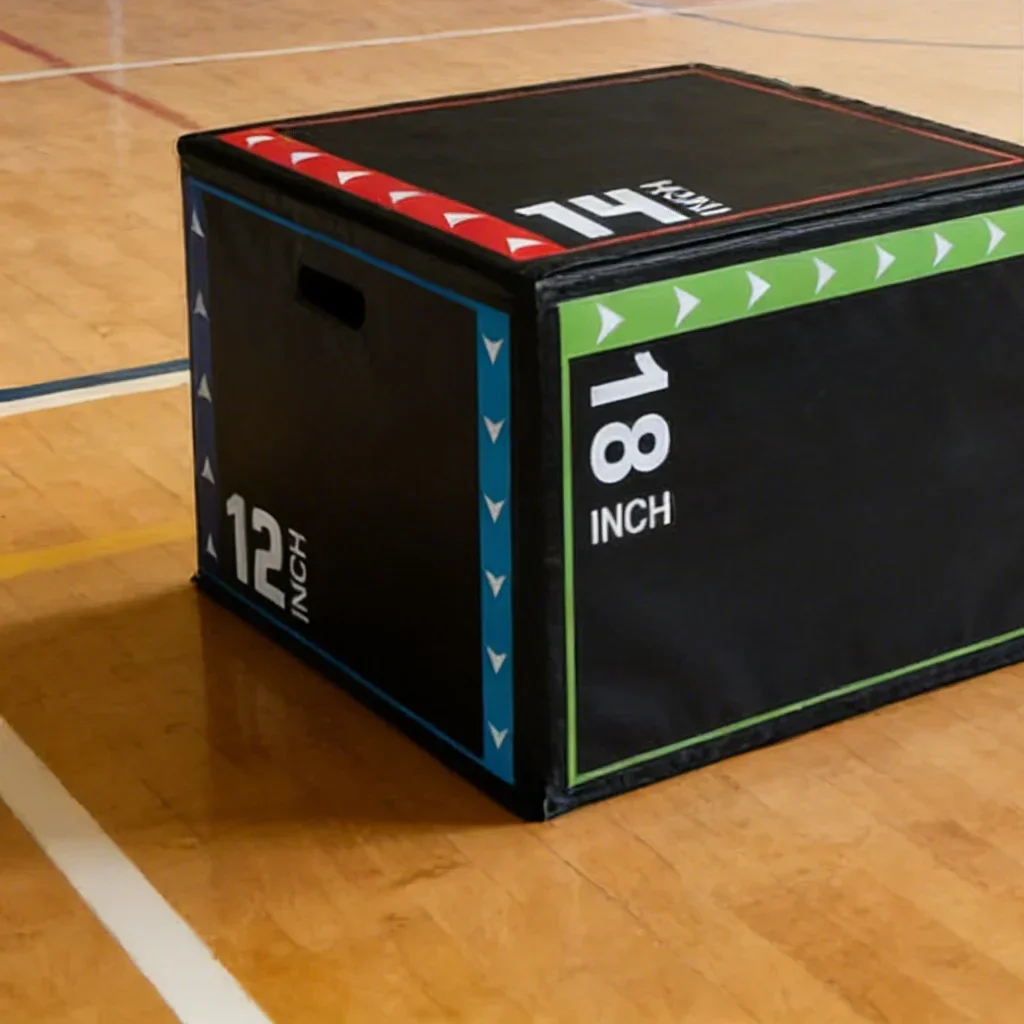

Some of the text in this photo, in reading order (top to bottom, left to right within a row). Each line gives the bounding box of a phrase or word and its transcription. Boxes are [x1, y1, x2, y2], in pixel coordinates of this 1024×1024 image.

[514, 188, 691, 239] 14
[590, 351, 671, 484] 18
[226, 493, 285, 610] 12
[591, 490, 672, 545] INCH
[287, 528, 310, 624] INCH
